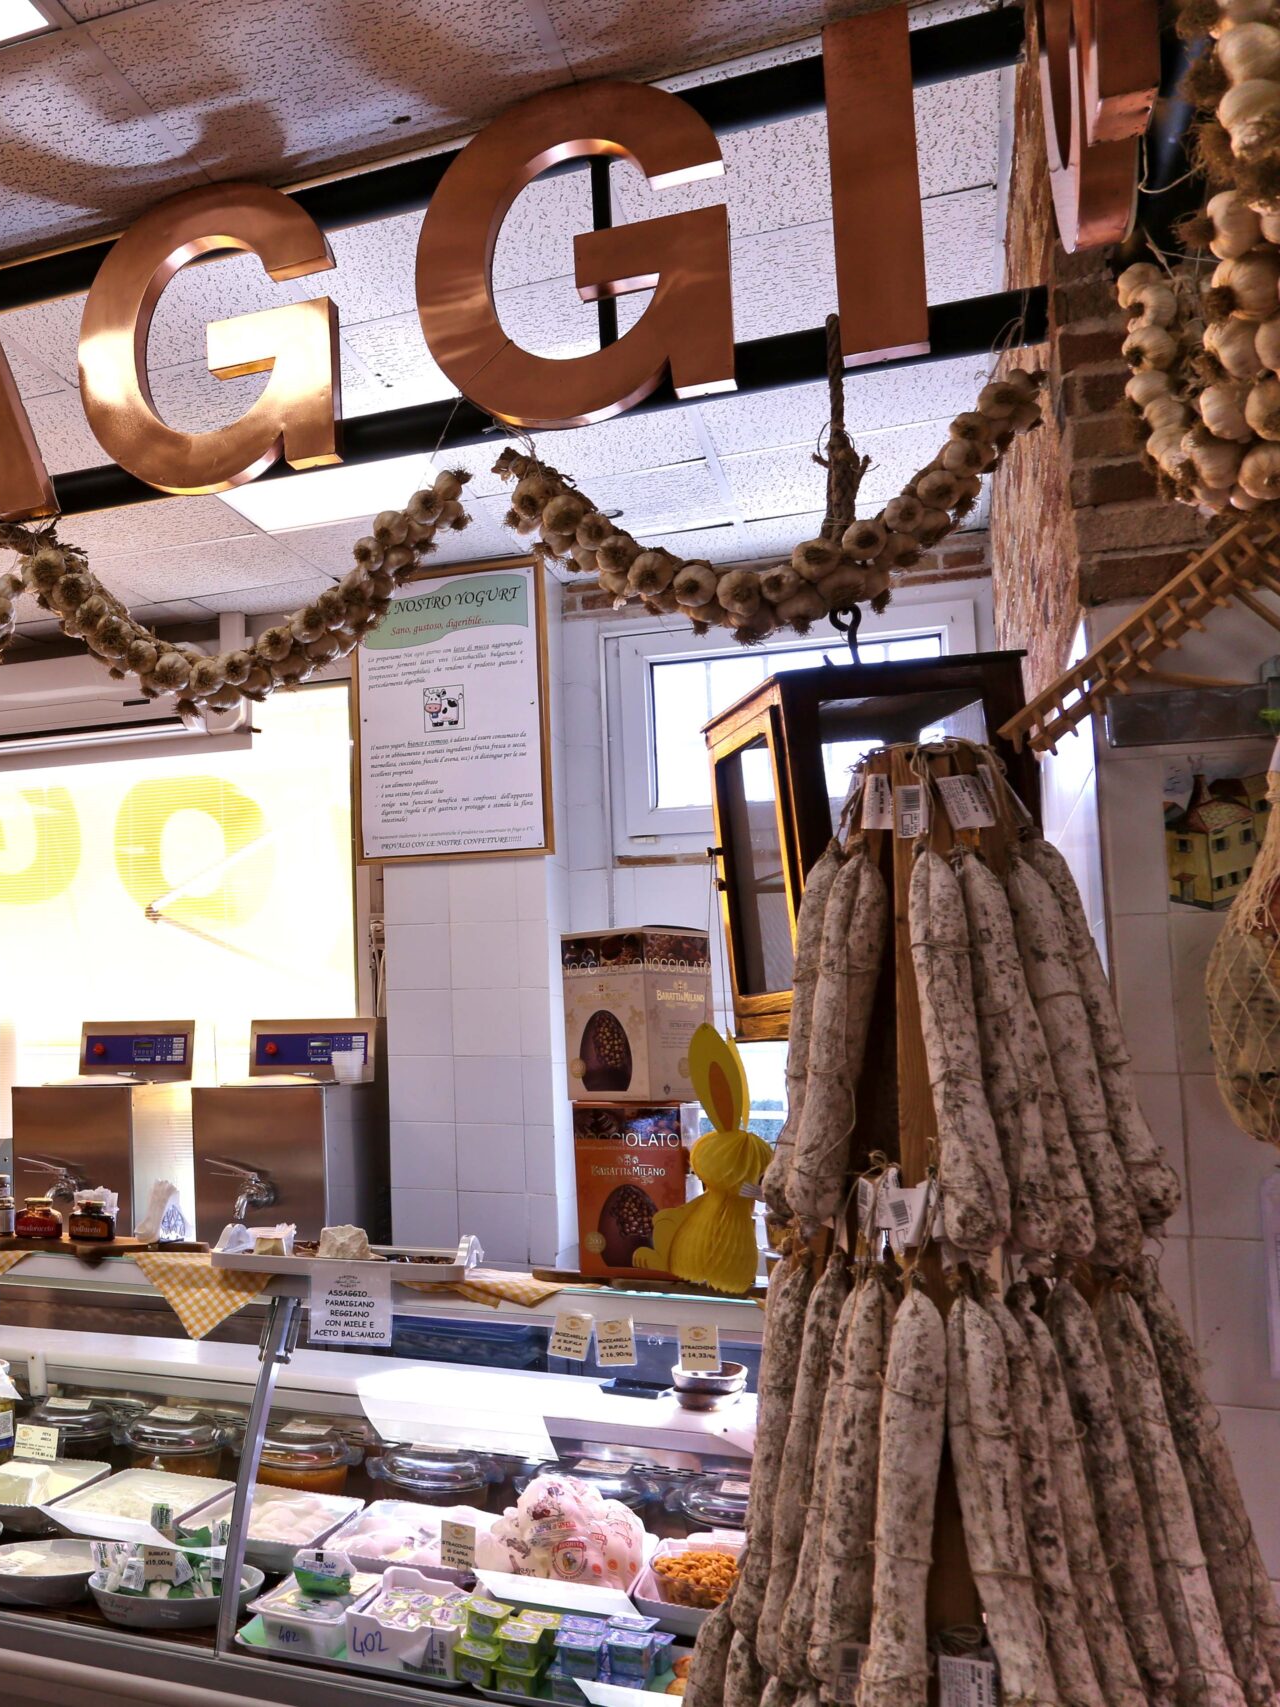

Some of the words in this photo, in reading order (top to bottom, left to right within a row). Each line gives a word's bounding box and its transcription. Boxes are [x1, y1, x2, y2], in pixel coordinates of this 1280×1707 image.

[394, 594, 452, 615] NOSTRO
[454, 585, 522, 608] YOGURT
[391, 625, 412, 636] Sano,
[413, 622, 444, 635] gustoso,
[392, 750, 421, 758] abbinamento
[410, 790, 423, 798] fonte
[473, 794, 496, 802] confronti
[381, 842, 410, 850] PROVALO
[436, 838, 462, 847] NOSTRE
[644, 957, 712, 976] NOCCIOLATO
[325, 1298, 375, 1308] PARMIGIANO
[330, 1310, 370, 1318] REGGIANO
[344, 1320, 367, 1328] MIELE
[314, 1329, 338, 1337] ACETO
[341, 1330, 386, 1339] BALSAMICO
[555, 1331, 588, 1340] MOZZARELLA
[352, 1626, 389, 1657] 402
